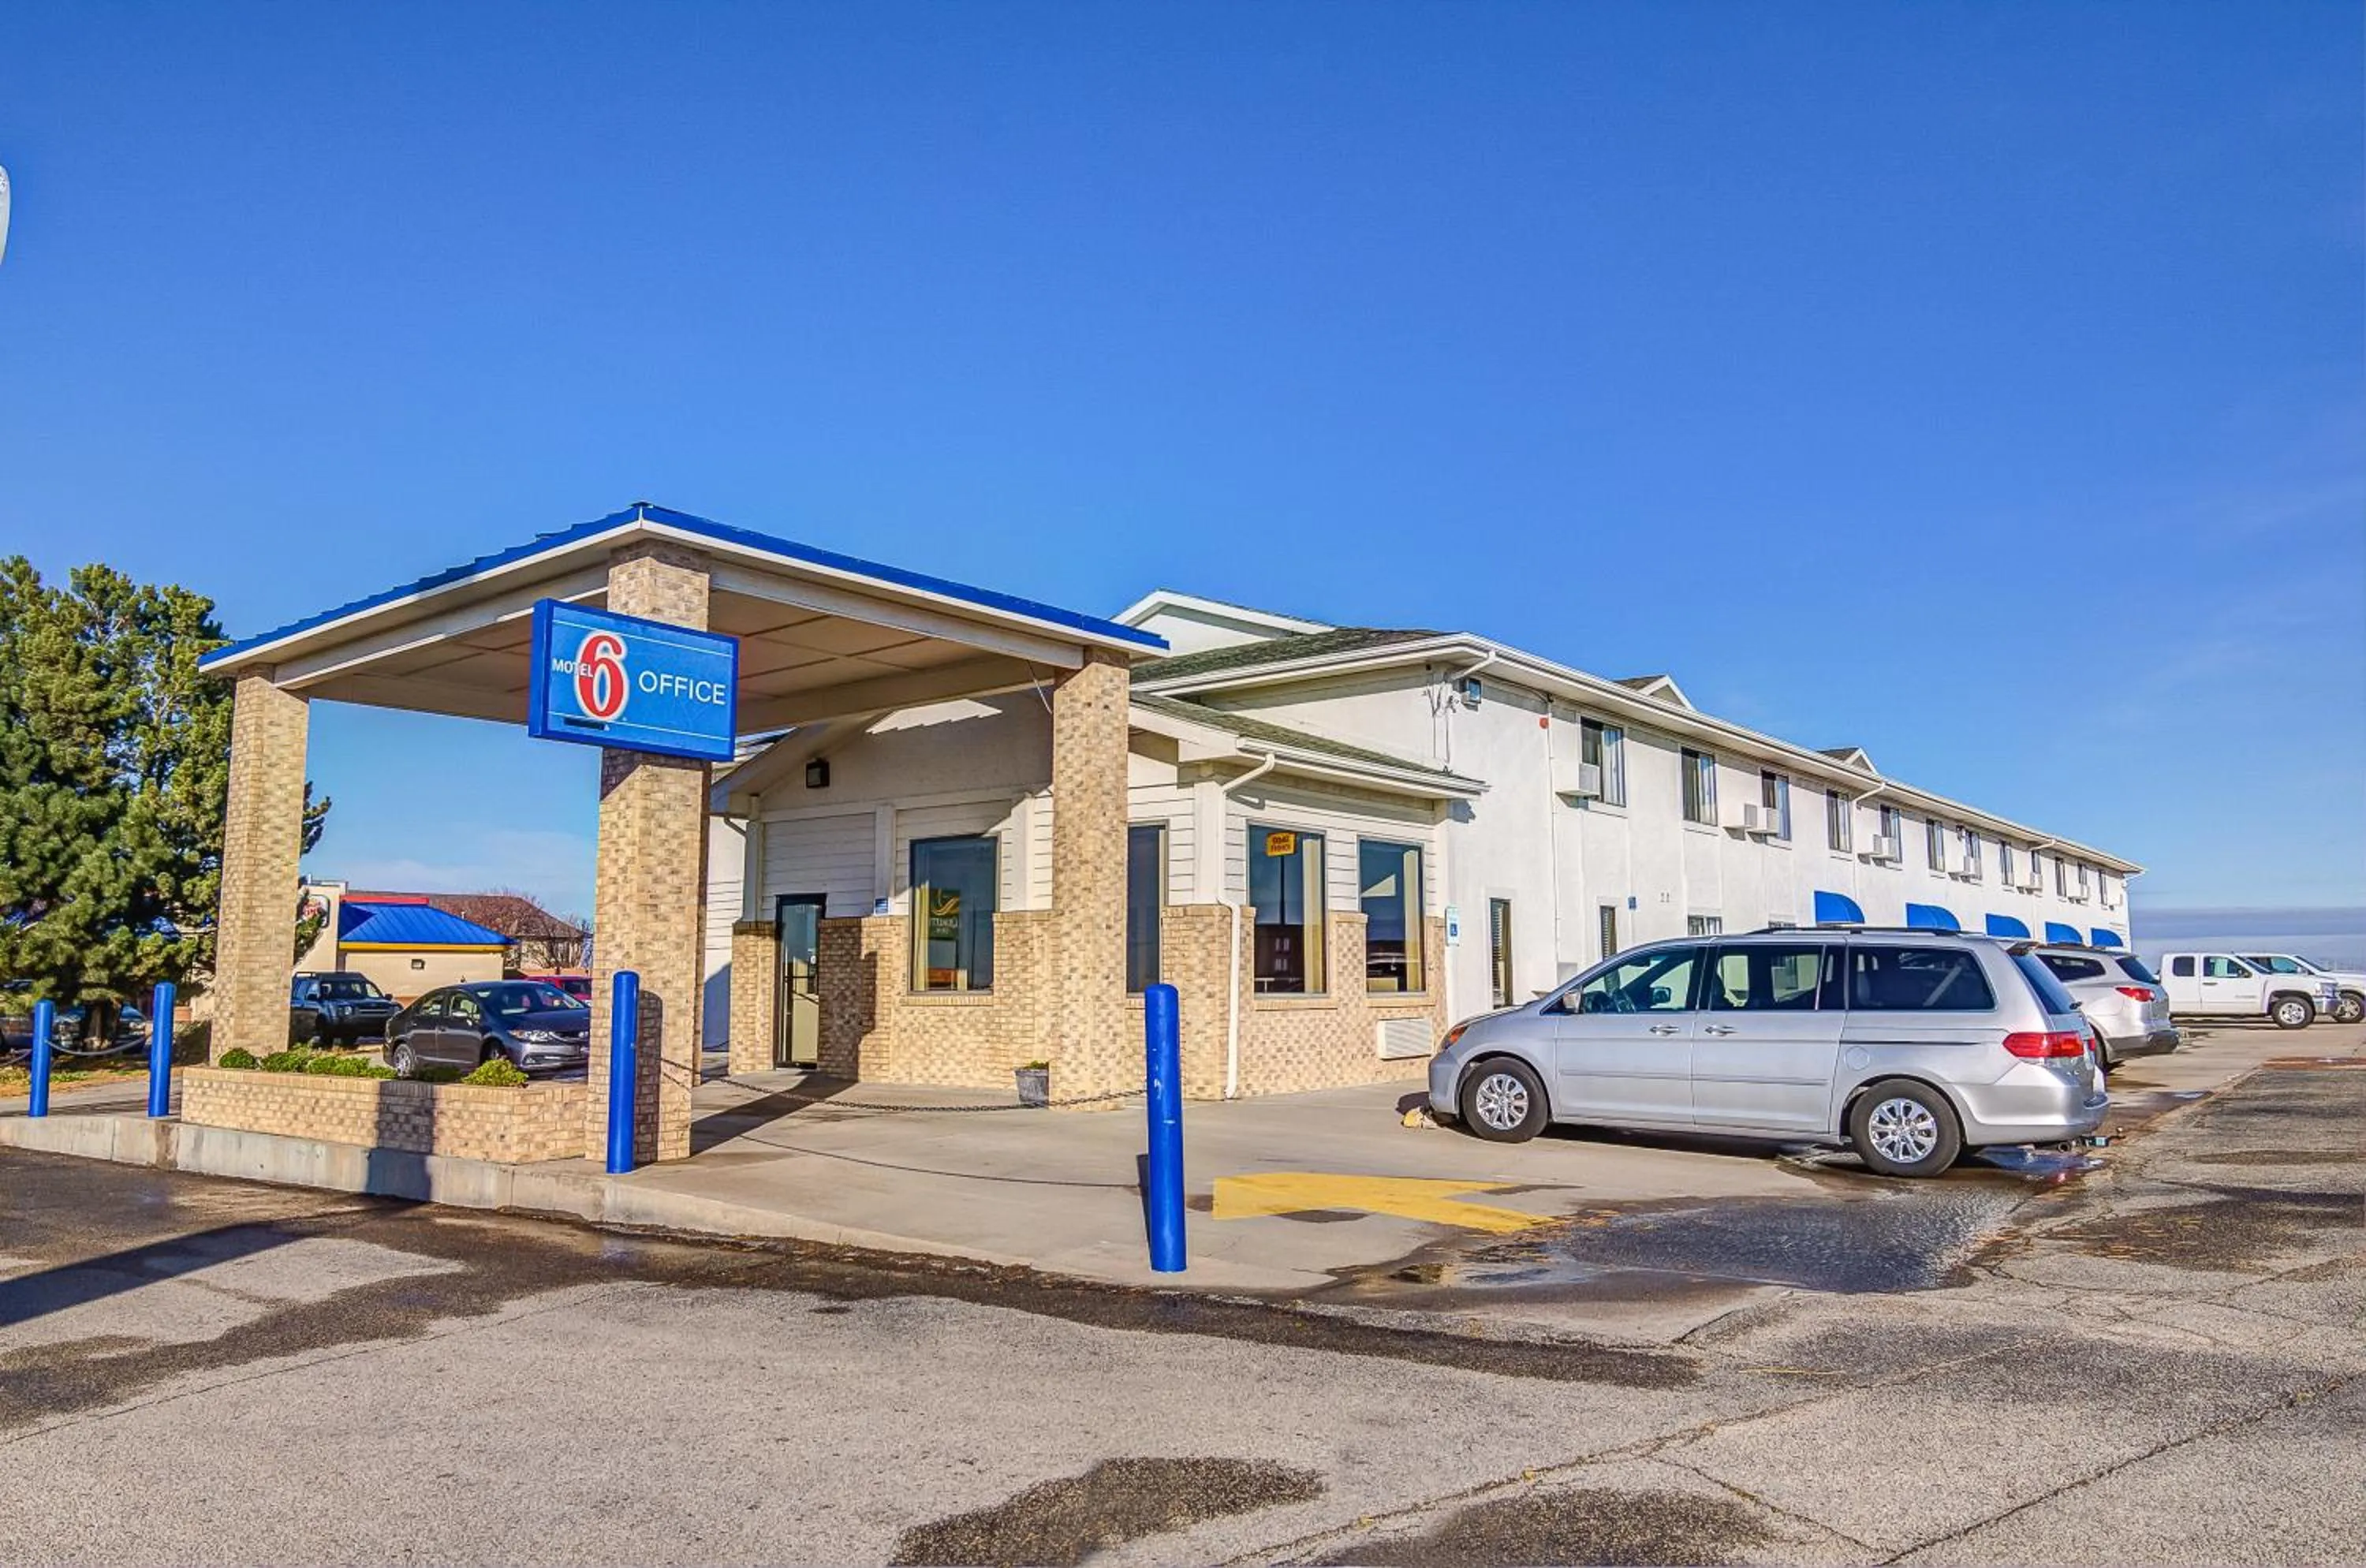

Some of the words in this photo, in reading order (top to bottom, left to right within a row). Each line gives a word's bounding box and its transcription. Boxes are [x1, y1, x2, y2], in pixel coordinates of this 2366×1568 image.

[552, 657, 594, 678] MOTEL
[574, 631, 629, 719] 6
[638, 670, 726, 705] OFFICE
